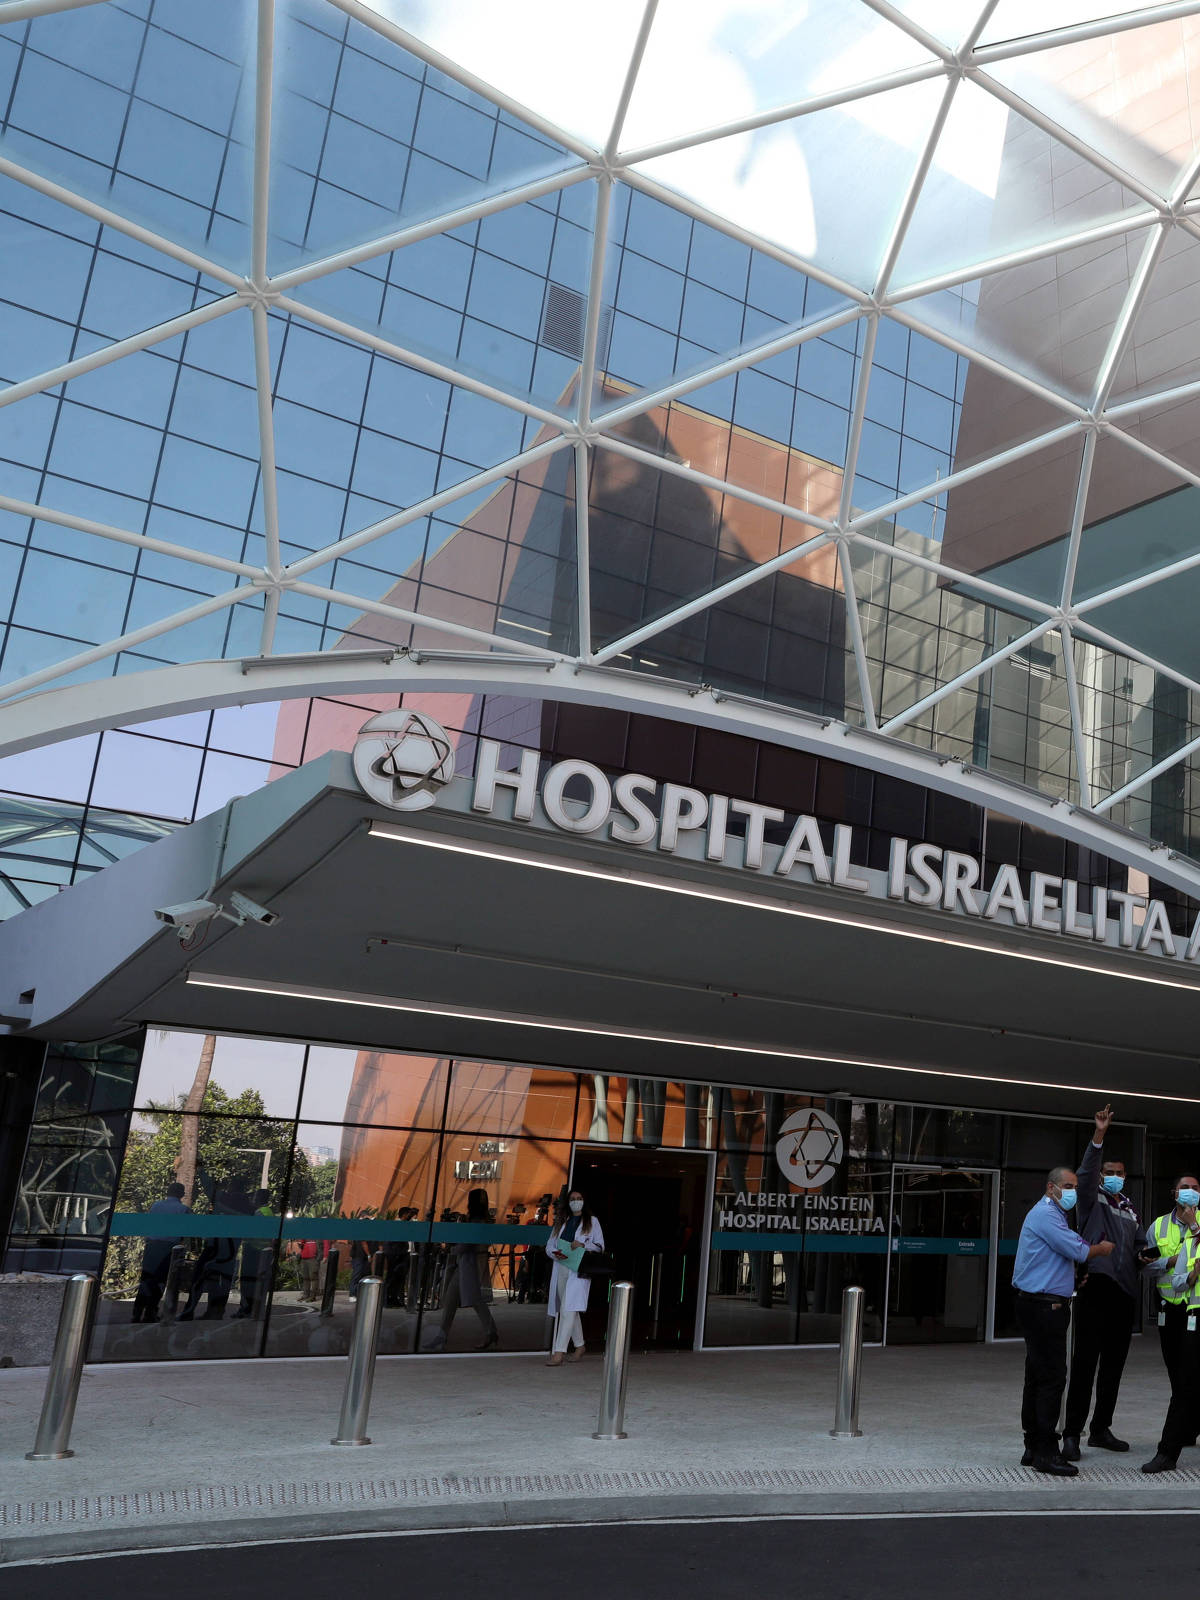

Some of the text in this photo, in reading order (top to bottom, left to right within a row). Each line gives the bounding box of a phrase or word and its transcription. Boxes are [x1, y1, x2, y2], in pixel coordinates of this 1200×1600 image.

[470, 739, 870, 892] HOSPITAL
[887, 836, 1177, 957] ISRAELITA
[734, 1191, 874, 1212] ALBERT EINSTEIN
[719, 1210, 885, 1233] HOSPITAL ISRAELITA
